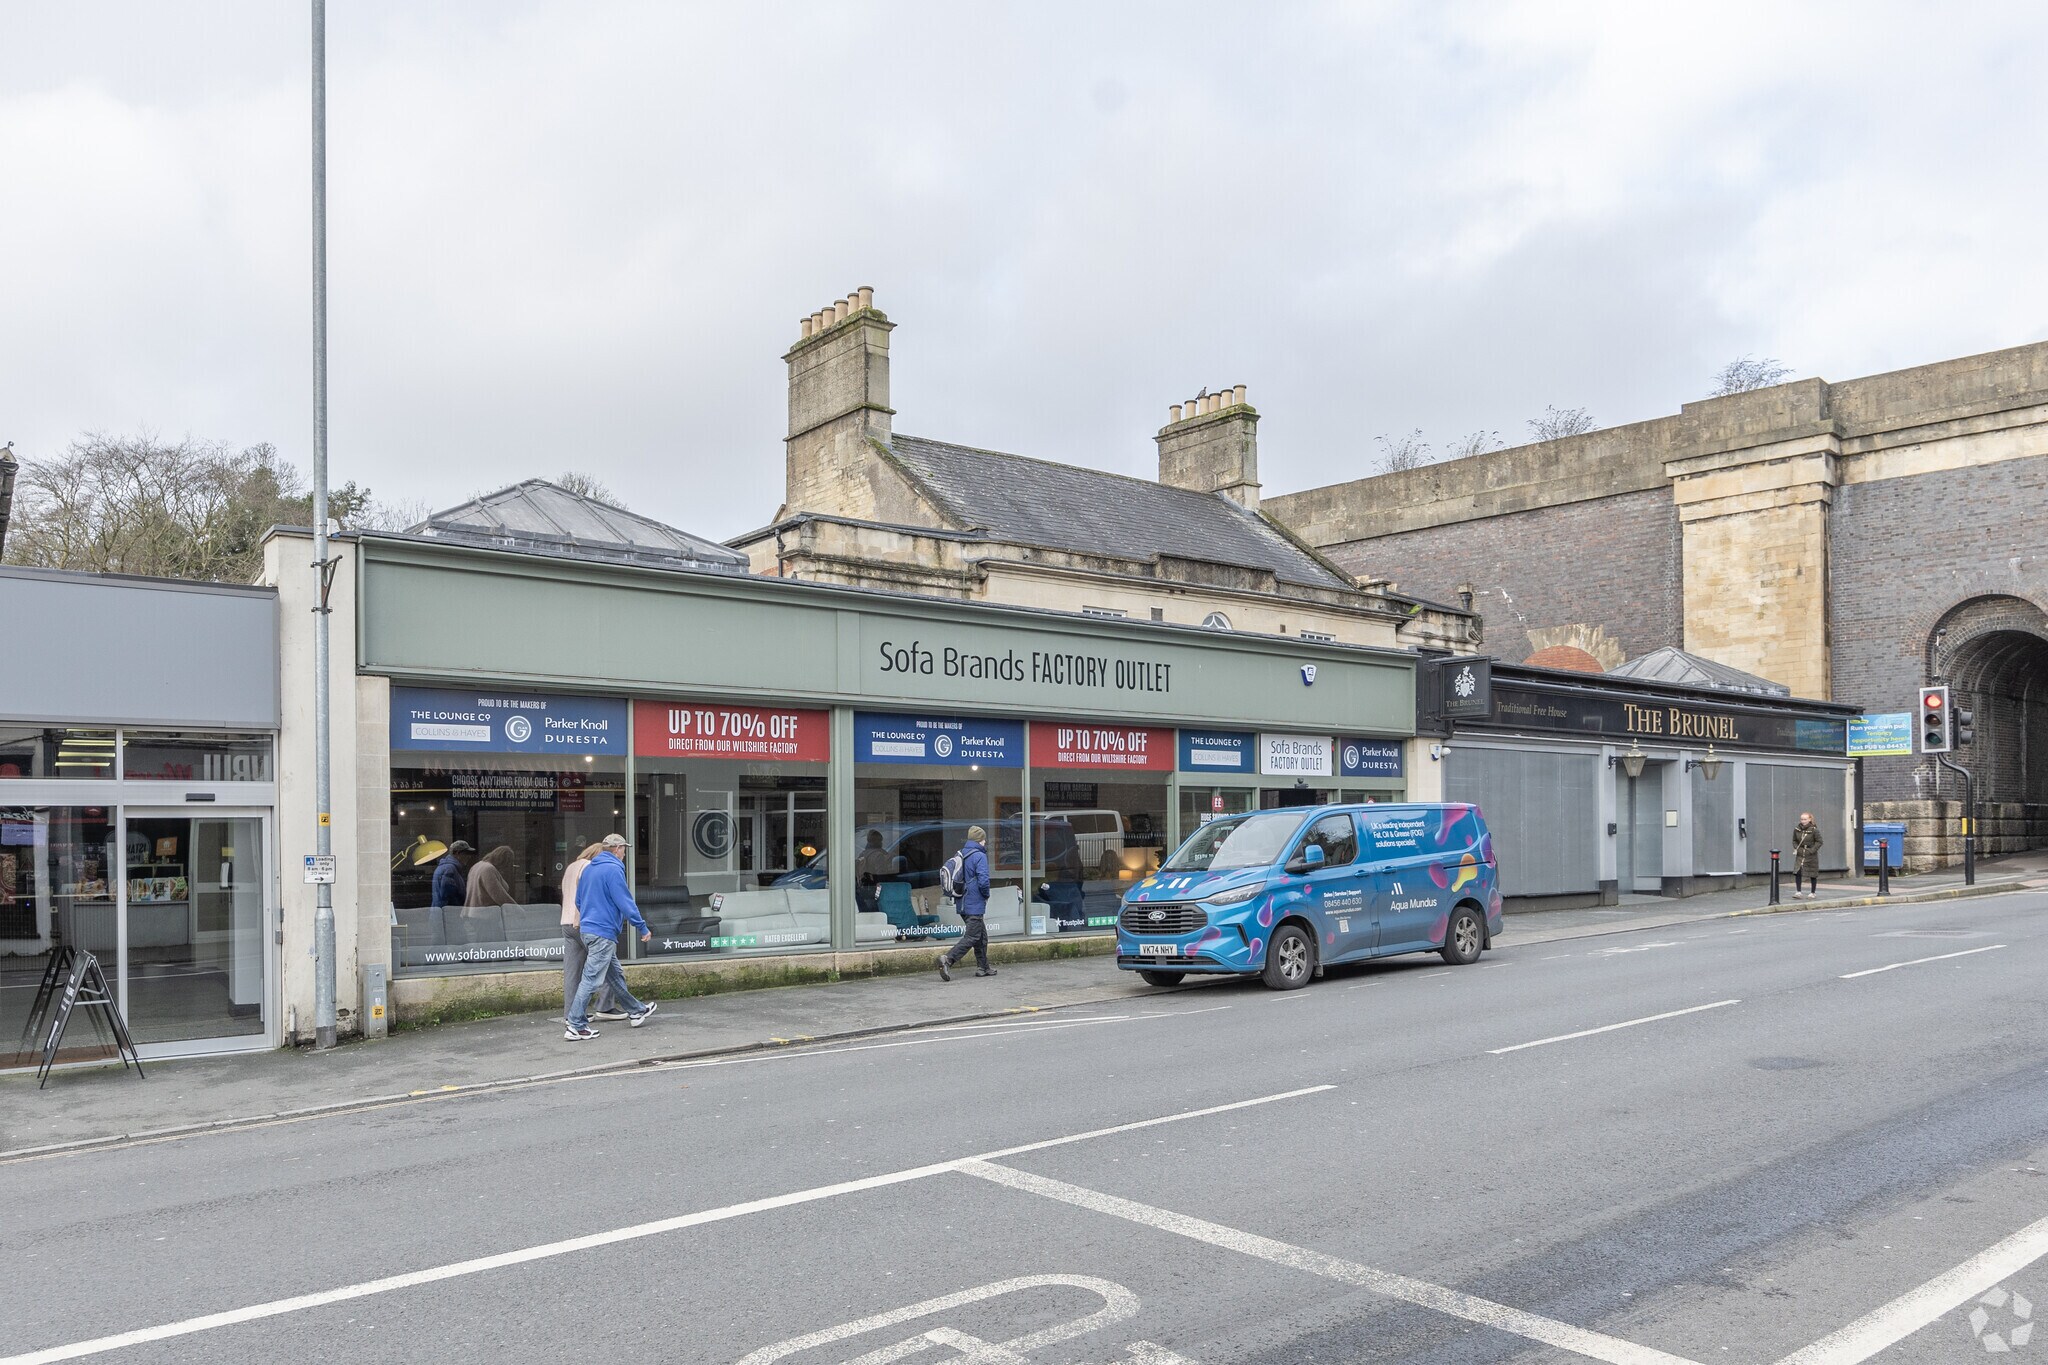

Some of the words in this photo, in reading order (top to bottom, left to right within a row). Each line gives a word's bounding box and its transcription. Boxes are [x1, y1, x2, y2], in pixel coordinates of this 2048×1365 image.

[880, 641, 934, 675] Sofa
[943, 647, 1025, 681] Brands
[1032, 651, 1107, 687] FACTORY
[1115, 659, 1171, 693] OUTLET
[477, 698, 495, 708] PROUD
[495, 699, 502, 708] TO
[503, 699, 509, 708] BE
[510, 700, 519, 709] THE
[520, 700, 540, 709] MAKERS
[540, 701, 547, 710] OF
[1497, 701, 1532, 715] Traditional
[1533, 705, 1547, 716] Free
[1548, 706, 1567, 718] House
[411, 710, 431, 719] THE
[433, 711, 476, 721] LOUNGE
[1624, 703, 1662, 734] THE
[1668, 708, 1739, 740] BRUNEL
[545, 717, 579, 729] Parker
[580, 719, 608, 731] Knoll
[668, 709, 691, 734] UP
[695, 710, 715, 735] TO
[720, 712, 766, 738] 70%
[770, 715, 798, 739] OFF
[415, 727, 451, 737] COLLINS
[452, 729, 459, 737] &
[460, 729, 487, 738] HAYES
[872, 731, 885, 739] THE
[887, 732, 915, 740] LOUNGE
[545, 734, 608, 745] DURESTA
[961, 735, 984, 746] Parker
[985, 737, 1005, 747] Knoll
[1057, 728, 1074, 749] UP
[1076, 729, 1090, 750] TO
[1093, 730, 1125, 751] 70%
[1128, 732, 1148, 752] OFF
[1191, 737, 1204, 745] THE
[1205, 738, 1232, 747] LOUNGE
[669, 738, 693, 750] DIRECT
[695, 739, 715, 751] FROM
[716, 740, 731, 752] OUR
[732, 740, 768, 753] WILTSHIRE
[769, 742, 798, 754] FACTORY
[1270, 740, 1290, 754] Sofa
[1292, 741, 1322, 756] Brands
[961, 750, 1005, 759] DURESTA
[1058, 752, 1075, 762] DIRECT
[1076, 753, 1090, 763] FROM
[1091, 753, 1101, 763] OUR
[1102, 753, 1127, 764] WILTSHIRE
[1127, 755, 1148, 765] FACTORY
[1362, 747, 1381, 757] Parker
[1382, 748, 1398, 758] Knoll
[1270, 756, 1299, 770] FACTORY
[1300, 757, 1323, 770] OUTLET
[1362, 761, 1398, 770] DURESTA
[452, 774, 478, 786] CHOOSE
[480, 775, 513, 787] ANYTHING
[514, 776, 533, 787] FROM
[534, 777, 548, 787] OUR
[452, 787, 480, 798] BRANDS
[488, 788, 505, 799] ONLY
[505, 789, 518, 799] PAY
[519, 789, 538, 800] 50%
[540, 789, 553, 800] RRP
[1390, 901, 1408, 913] Aqua
[1410, 898, 1438, 909] Mundus
[1062, 919, 1085, 927] Trustpilot
[674, 939, 706, 949] Trustpilot
[764, 934, 781, 943] RATED
[781, 933, 808, 942] EXCELLENT
[425, 945, 565, 962] www.sofabrandsfactoryout
[1142, 945, 1159, 954] VK74
[1160, 945, 1174, 954] NHY
